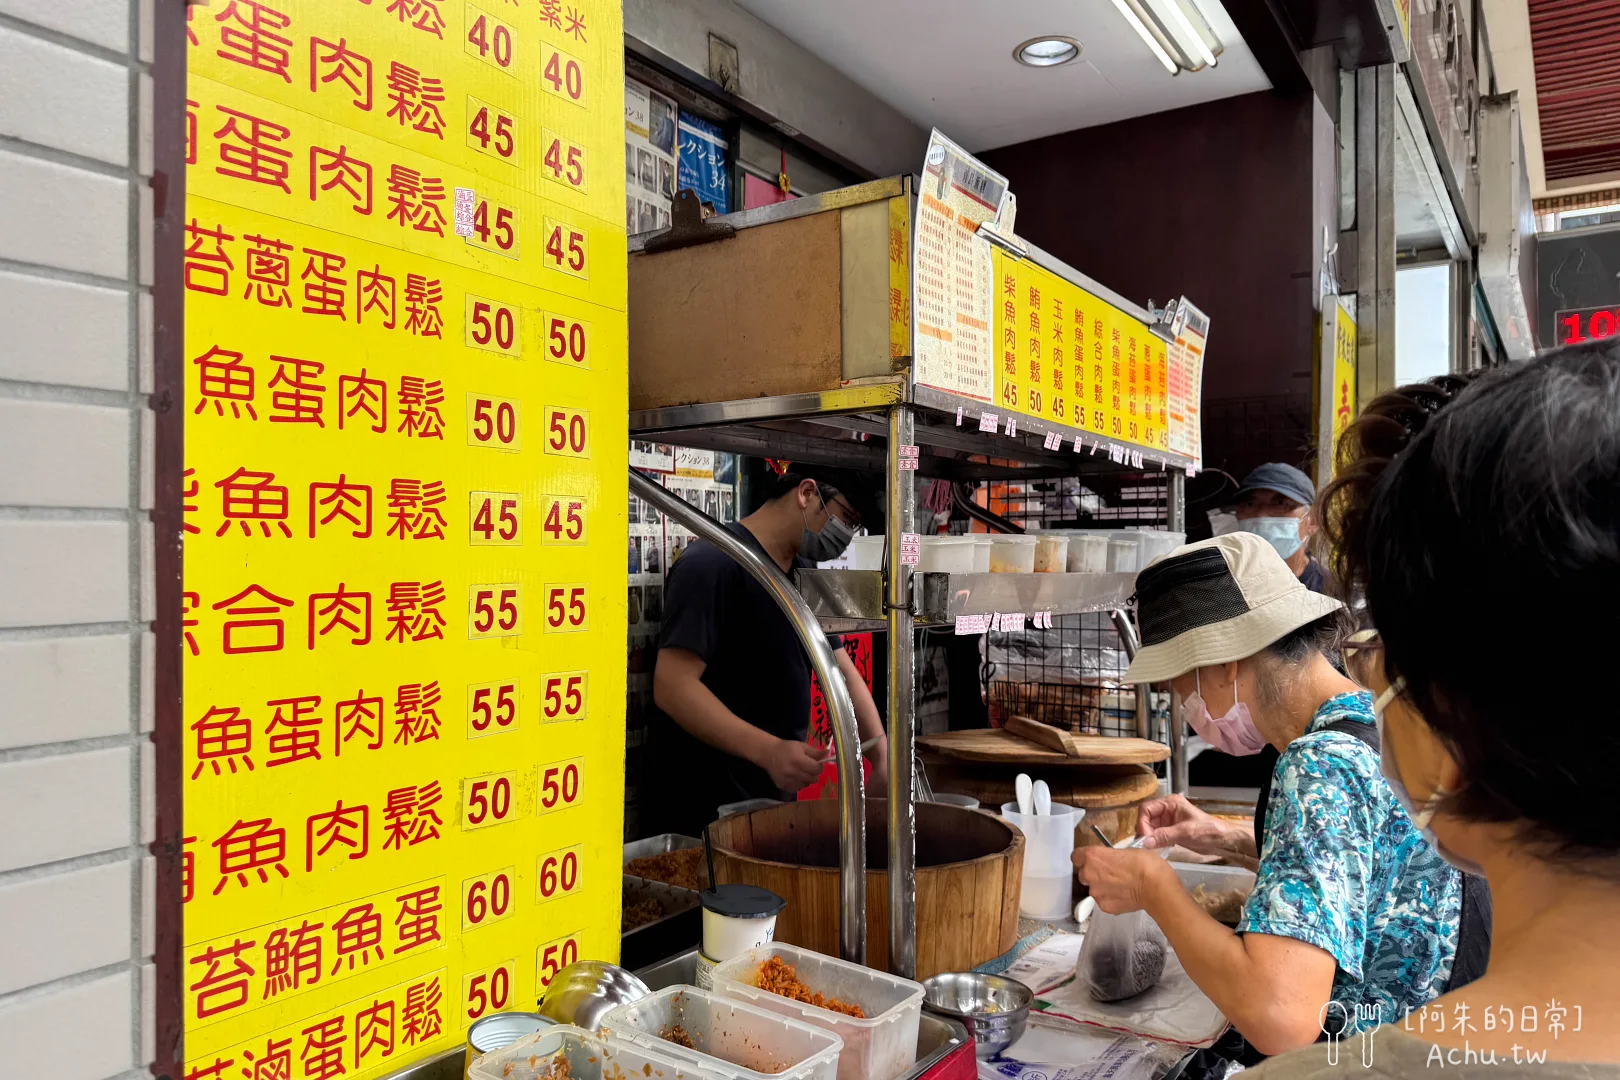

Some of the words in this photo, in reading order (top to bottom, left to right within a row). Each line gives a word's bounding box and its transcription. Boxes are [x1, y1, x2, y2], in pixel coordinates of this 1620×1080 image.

[468, 15, 512, 68] 40
[544, 51, 582, 100] 40
[186, 0, 446, 140] 蛋肉鬆
[470, 107, 514, 158] 45
[544, 138, 582, 186] 45
[710, 170, 726, 191] 34
[474, 200, 514, 250] 45
[547, 225, 584, 271] 45
[471, 301, 513, 350] 50
[550, 318, 586, 362] 50
[1003, 273, 1016, 375] 柴魚肉鬆
[1029, 286, 1041, 384] 鮪魚肉鬆
[1052, 298, 1063, 391] 玉米肉鬆
[1563, 308, 1620, 344] 10
[1074, 308, 1084, 398] 鮪魚蛋肉鬆
[1093, 318, 1103, 404] 綜合肉鬆
[193, 344, 446, 440] 魚蛋肉鬆
[473, 399, 515, 444] 50
[549, 411, 586, 453] 50
[1003, 382, 1017, 406] 45
[1030, 390, 1041, 412] 50
[1052, 397, 1064, 418] 45
[1074, 405, 1085, 425] 55
[1094, 410, 1104, 430] 55
[1112, 417, 1122, 435] 50
[1129, 422, 1138, 439] 50
[1145, 427, 1153, 443] 45
[1159, 431, 1168, 447] 45
[473, 499, 518, 540] 45
[544, 501, 583, 540] 45
[474, 590, 518, 633] 55
[548, 587, 586, 628] 55
[190, 680, 442, 780] 魚蛋肉鬆
[472, 684, 515, 731] 55
[544, 676, 582, 718] 55
[182, 780, 443, 904] 魚肉鬆
[467, 777, 511, 825] 50
[541, 763, 579, 808] 50
[189, 885, 443, 1019] 苔鮪魚蛋
[467, 873, 510, 924] 60
[539, 851, 577, 898] 60
[467, 967, 509, 1020] 50
